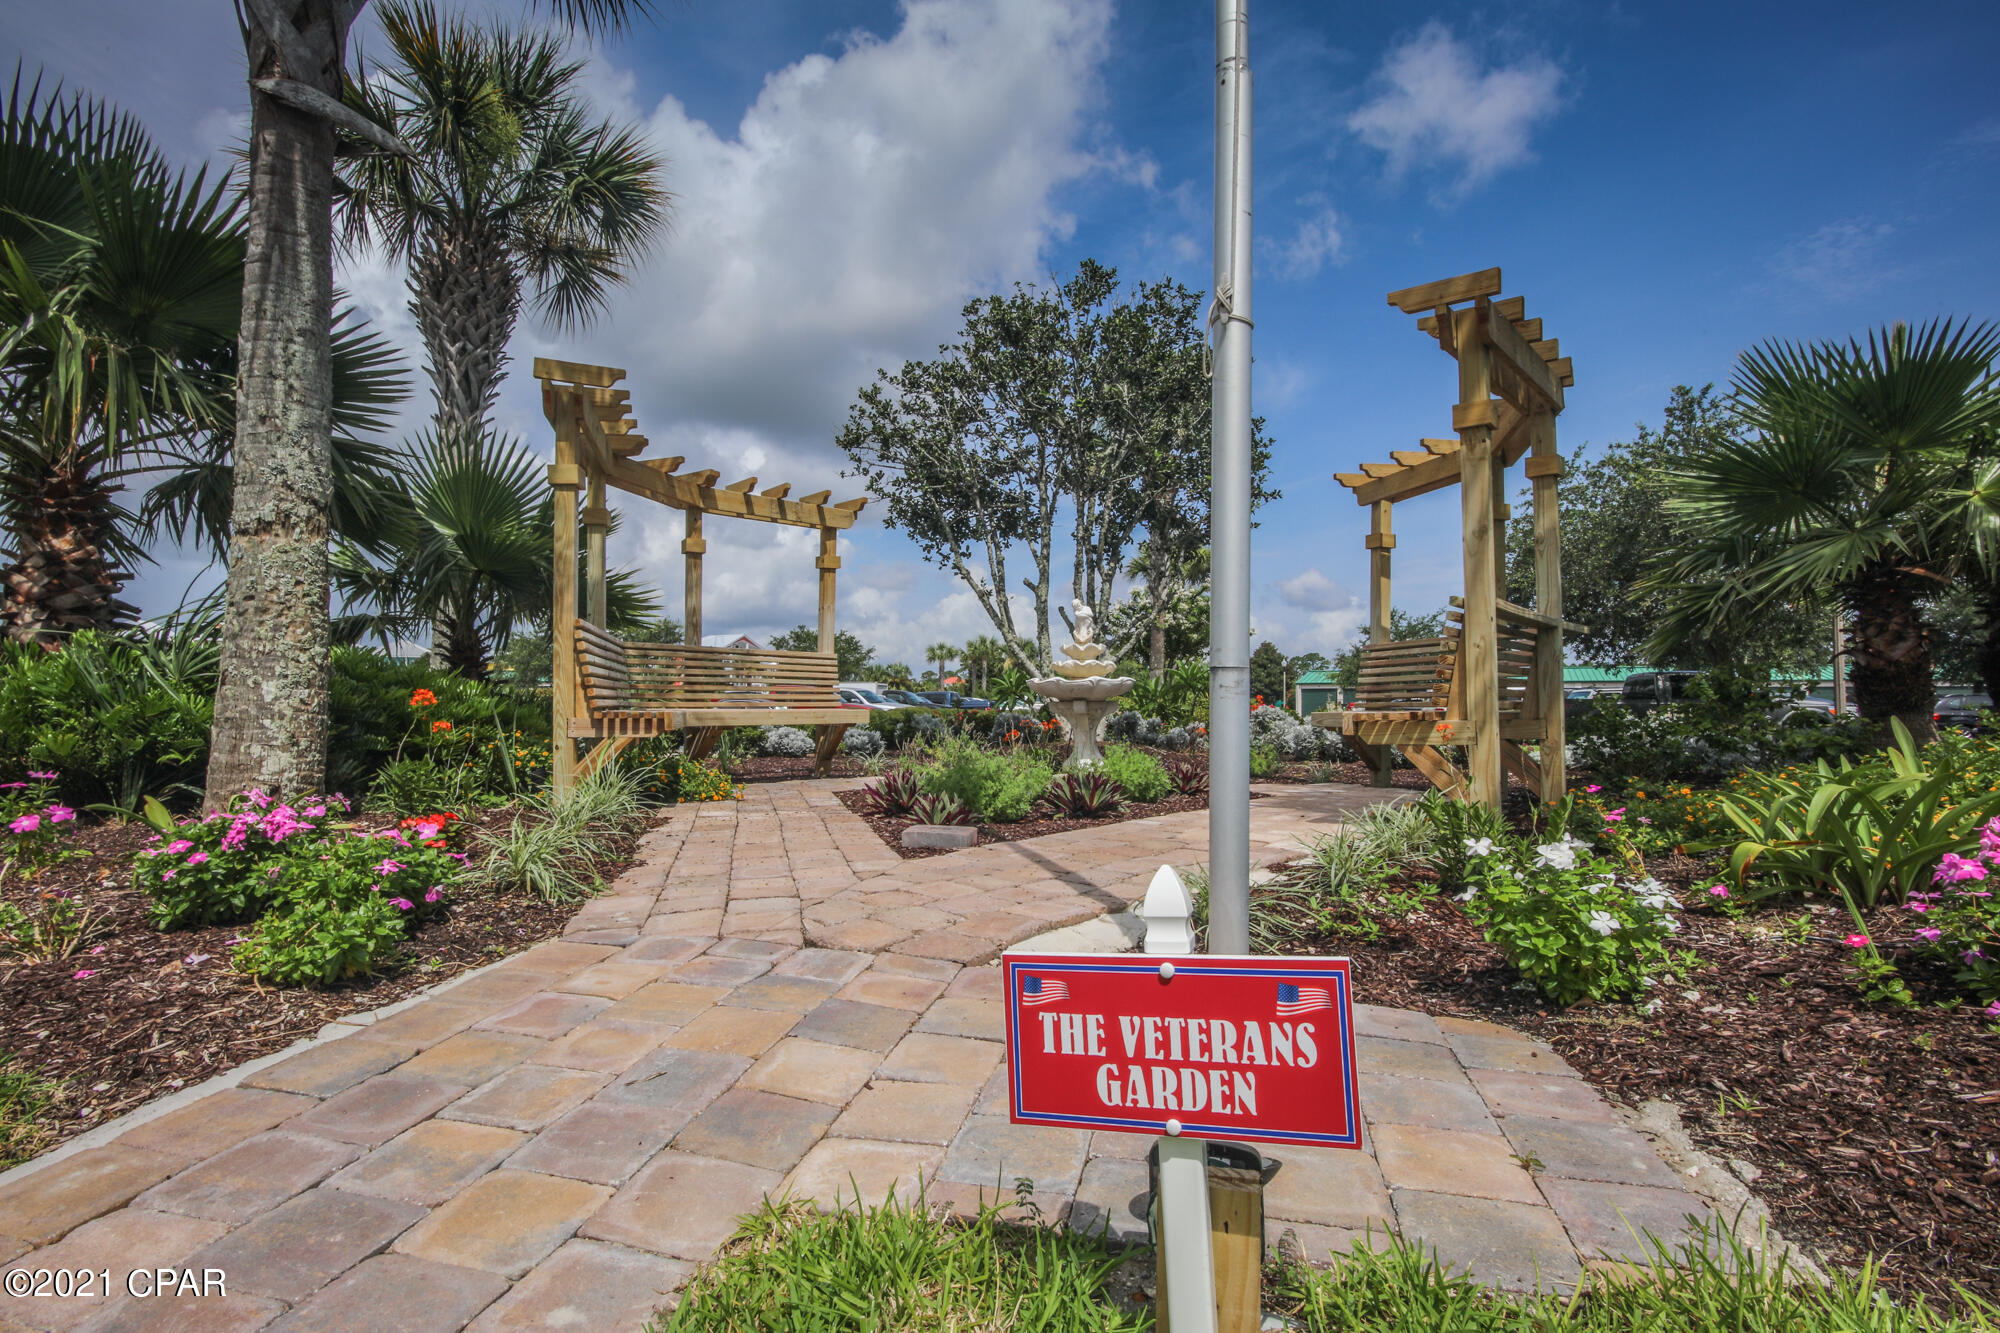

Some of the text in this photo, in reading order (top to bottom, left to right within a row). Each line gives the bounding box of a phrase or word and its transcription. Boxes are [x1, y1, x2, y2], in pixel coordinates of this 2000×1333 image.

[1038, 1011, 1318, 1069] THE VETERANS
[1096, 1063, 1258, 1116] GARDEN
